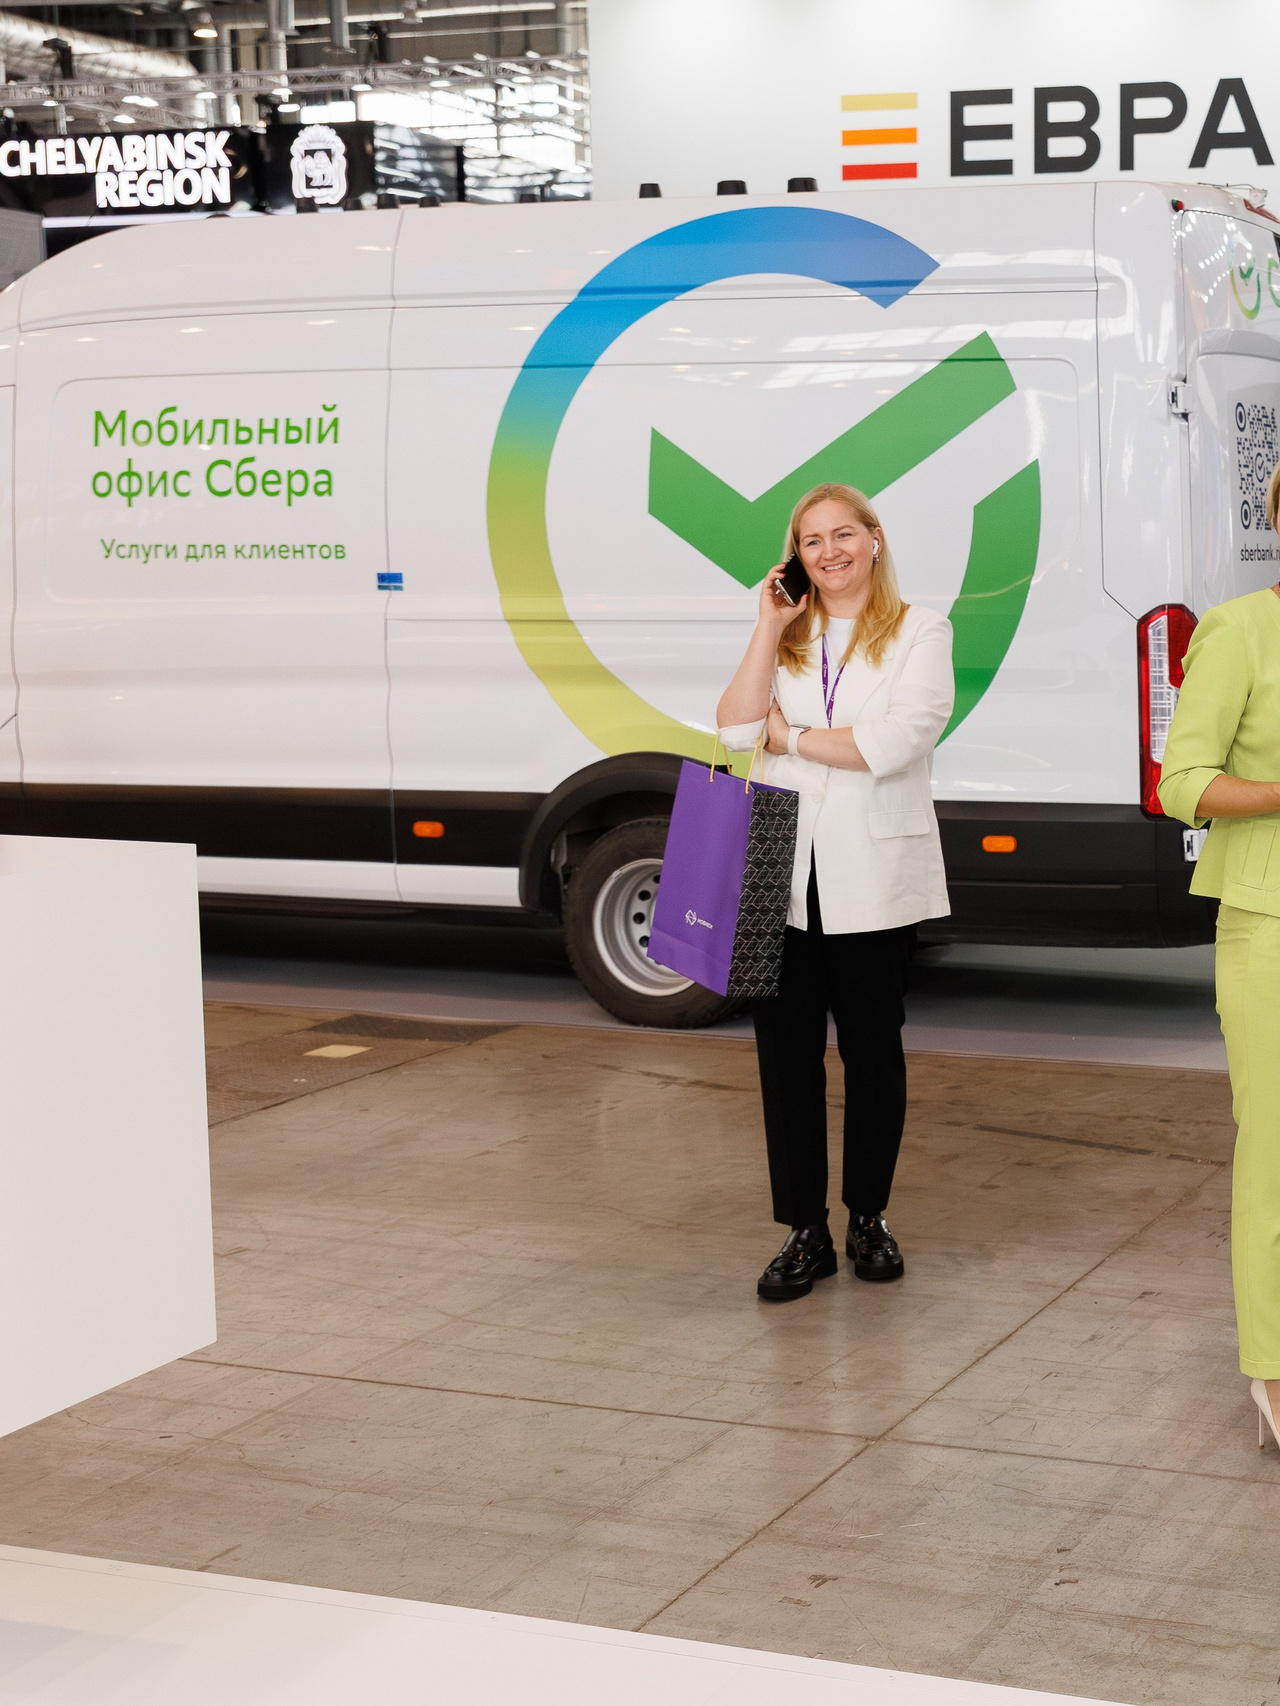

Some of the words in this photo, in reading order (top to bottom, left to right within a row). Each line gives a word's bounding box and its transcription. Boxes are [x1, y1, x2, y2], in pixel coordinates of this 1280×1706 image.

[0, 131, 232, 177] CHELYABINSK
[95, 167, 232, 208] REGION
[93, 403, 340, 448] Мобильный
[91, 458, 191, 507] офис
[205, 456, 333, 508] Сбера
[101, 538, 178, 564] Услуги
[185, 543, 227, 562] для
[234, 541, 347, 560] клиентов
